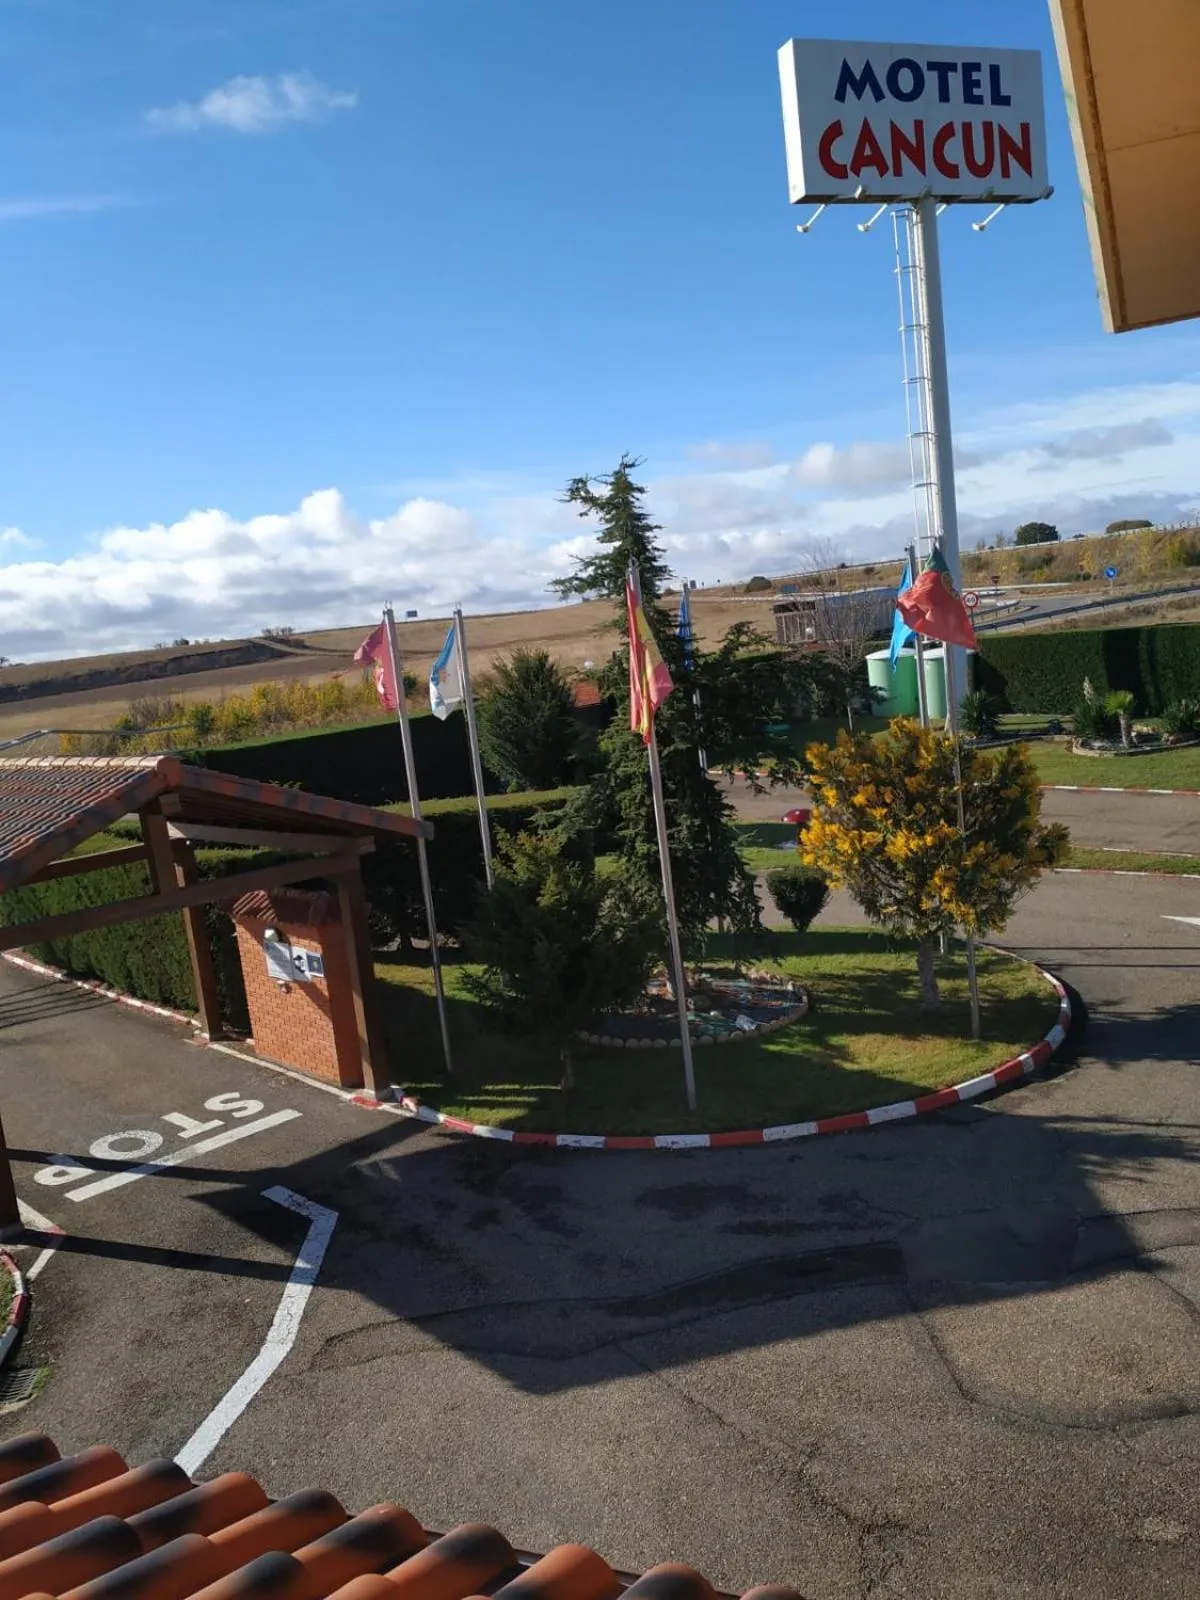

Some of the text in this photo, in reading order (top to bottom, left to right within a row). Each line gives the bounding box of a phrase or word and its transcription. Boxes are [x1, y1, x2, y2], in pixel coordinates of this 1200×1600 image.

[834, 57, 1011, 107] MOTEL
[818, 116, 1033, 180] CANCUN
[33, 1092, 264, 1186] STOP
